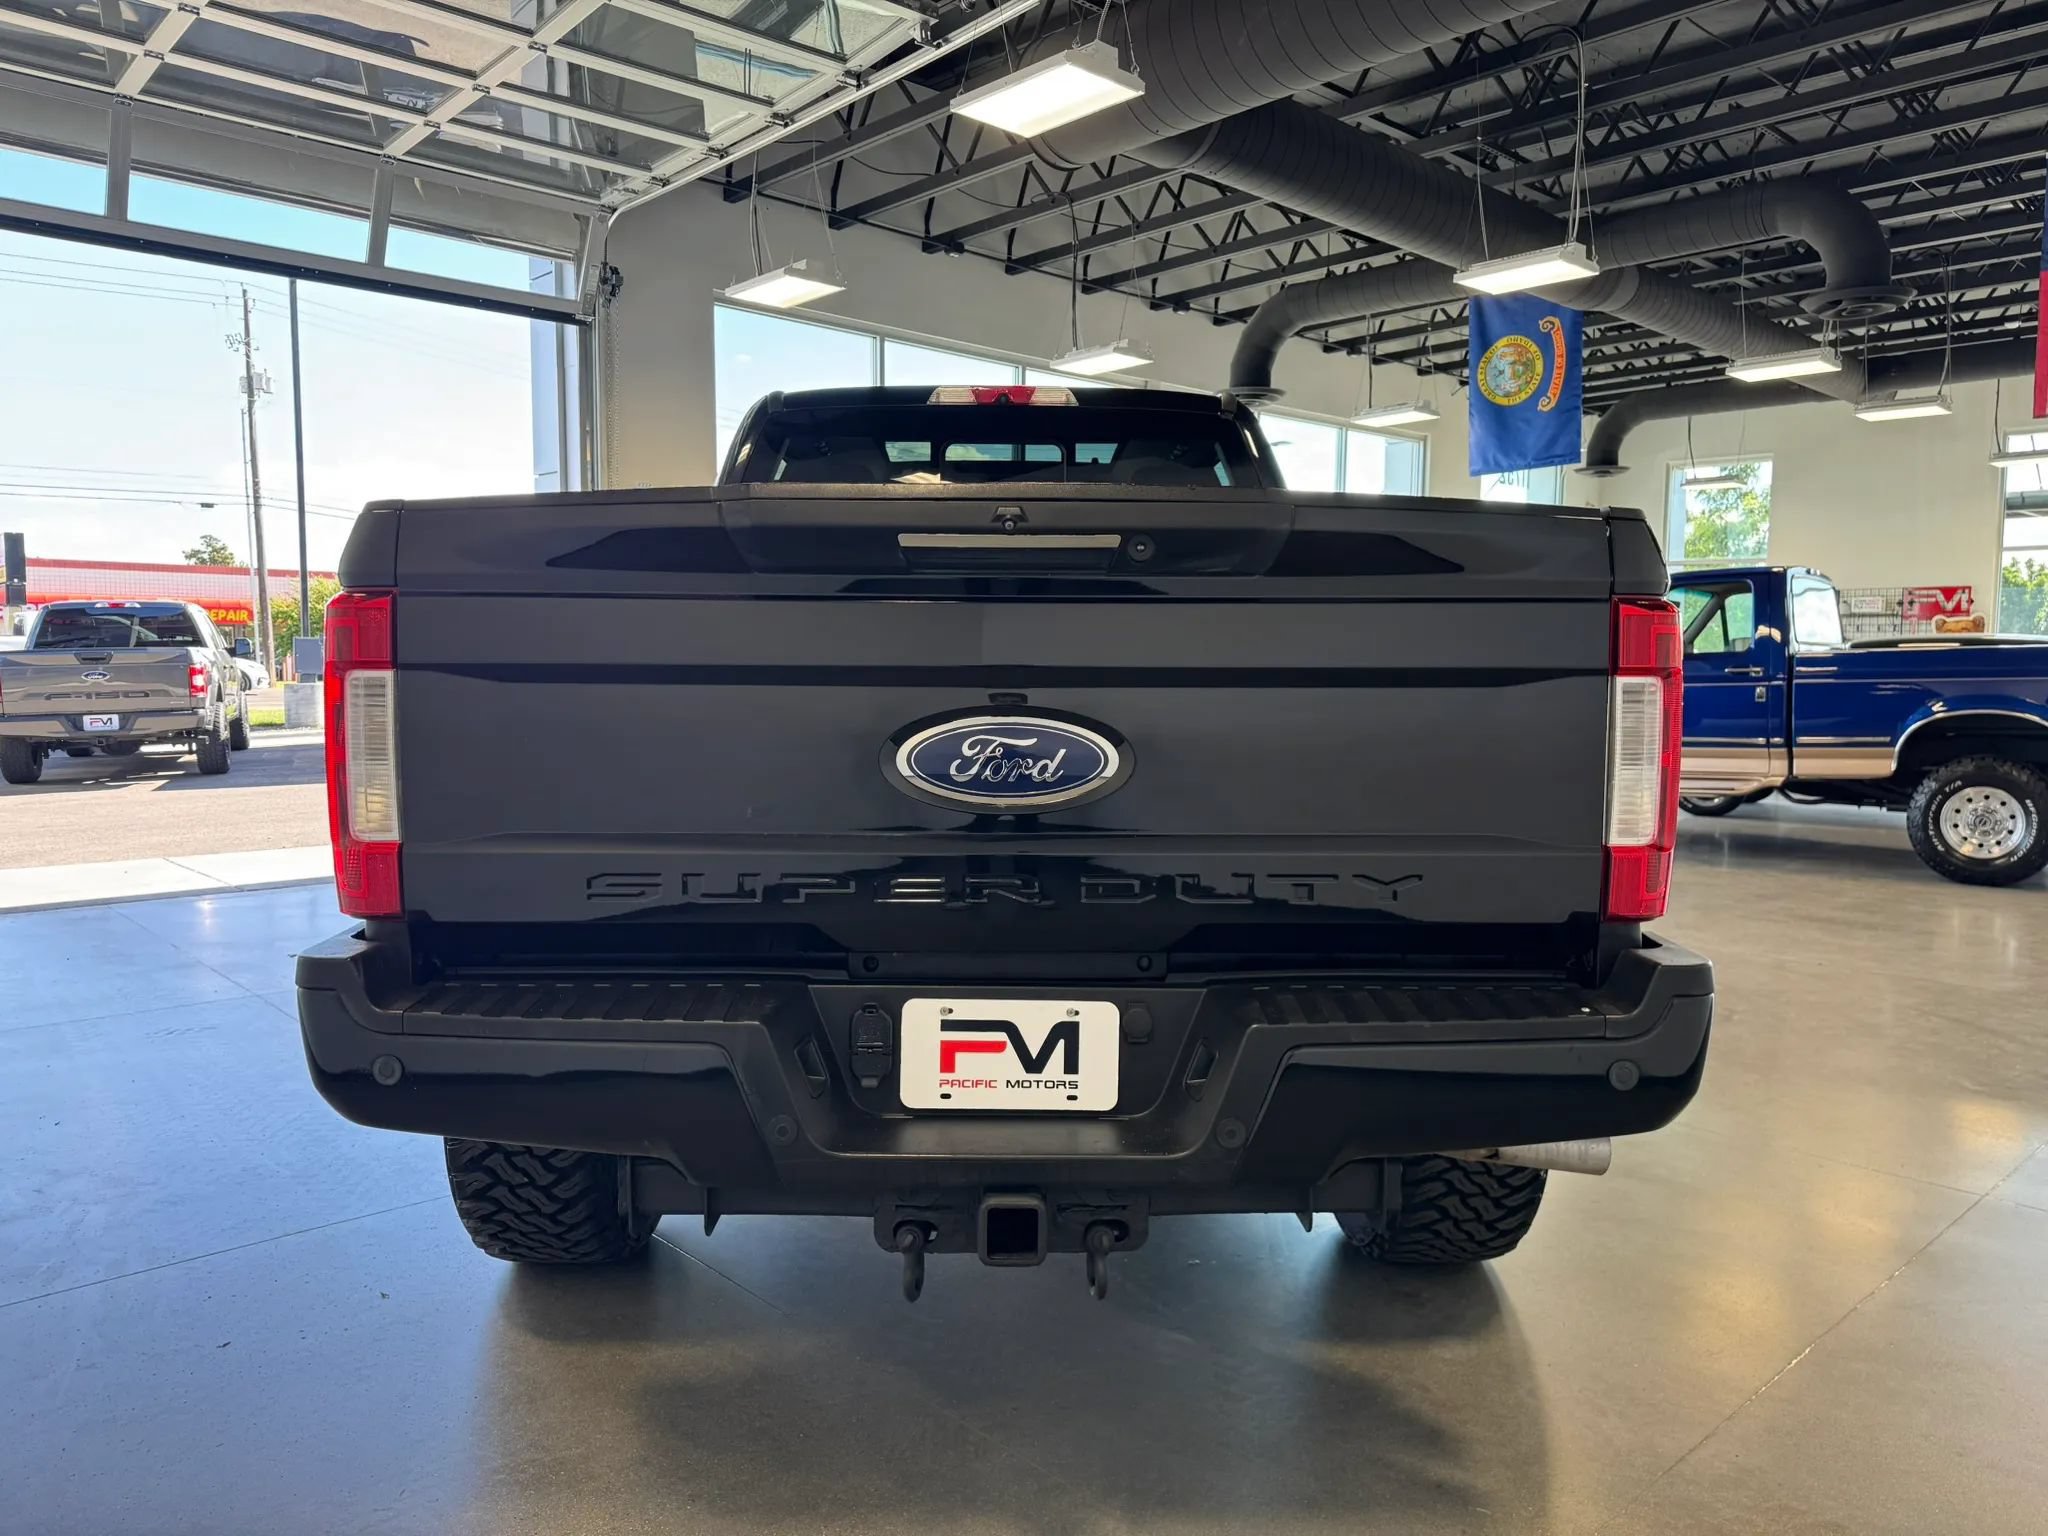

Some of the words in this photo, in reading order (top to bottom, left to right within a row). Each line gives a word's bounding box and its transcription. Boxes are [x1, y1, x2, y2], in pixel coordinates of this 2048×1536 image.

[1523, 372, 1541, 396] STATE
[1551, 368, 1563, 396] STATE
[208, 609, 249, 622] EPAIR
[949, 735, 1066, 785] Ford
[1944, 780, 1963, 793] T/A
[2010, 799, 2039, 863] BFGoodrich
[586, 872, 1043, 906] SUPER
[1079, 872, 1424, 906] DUTY
[940, 1019, 1080, 1075] PM
[939, 1079, 998, 1089] PACIFIC
[1006, 1079, 1079, 1090] MOTORS
